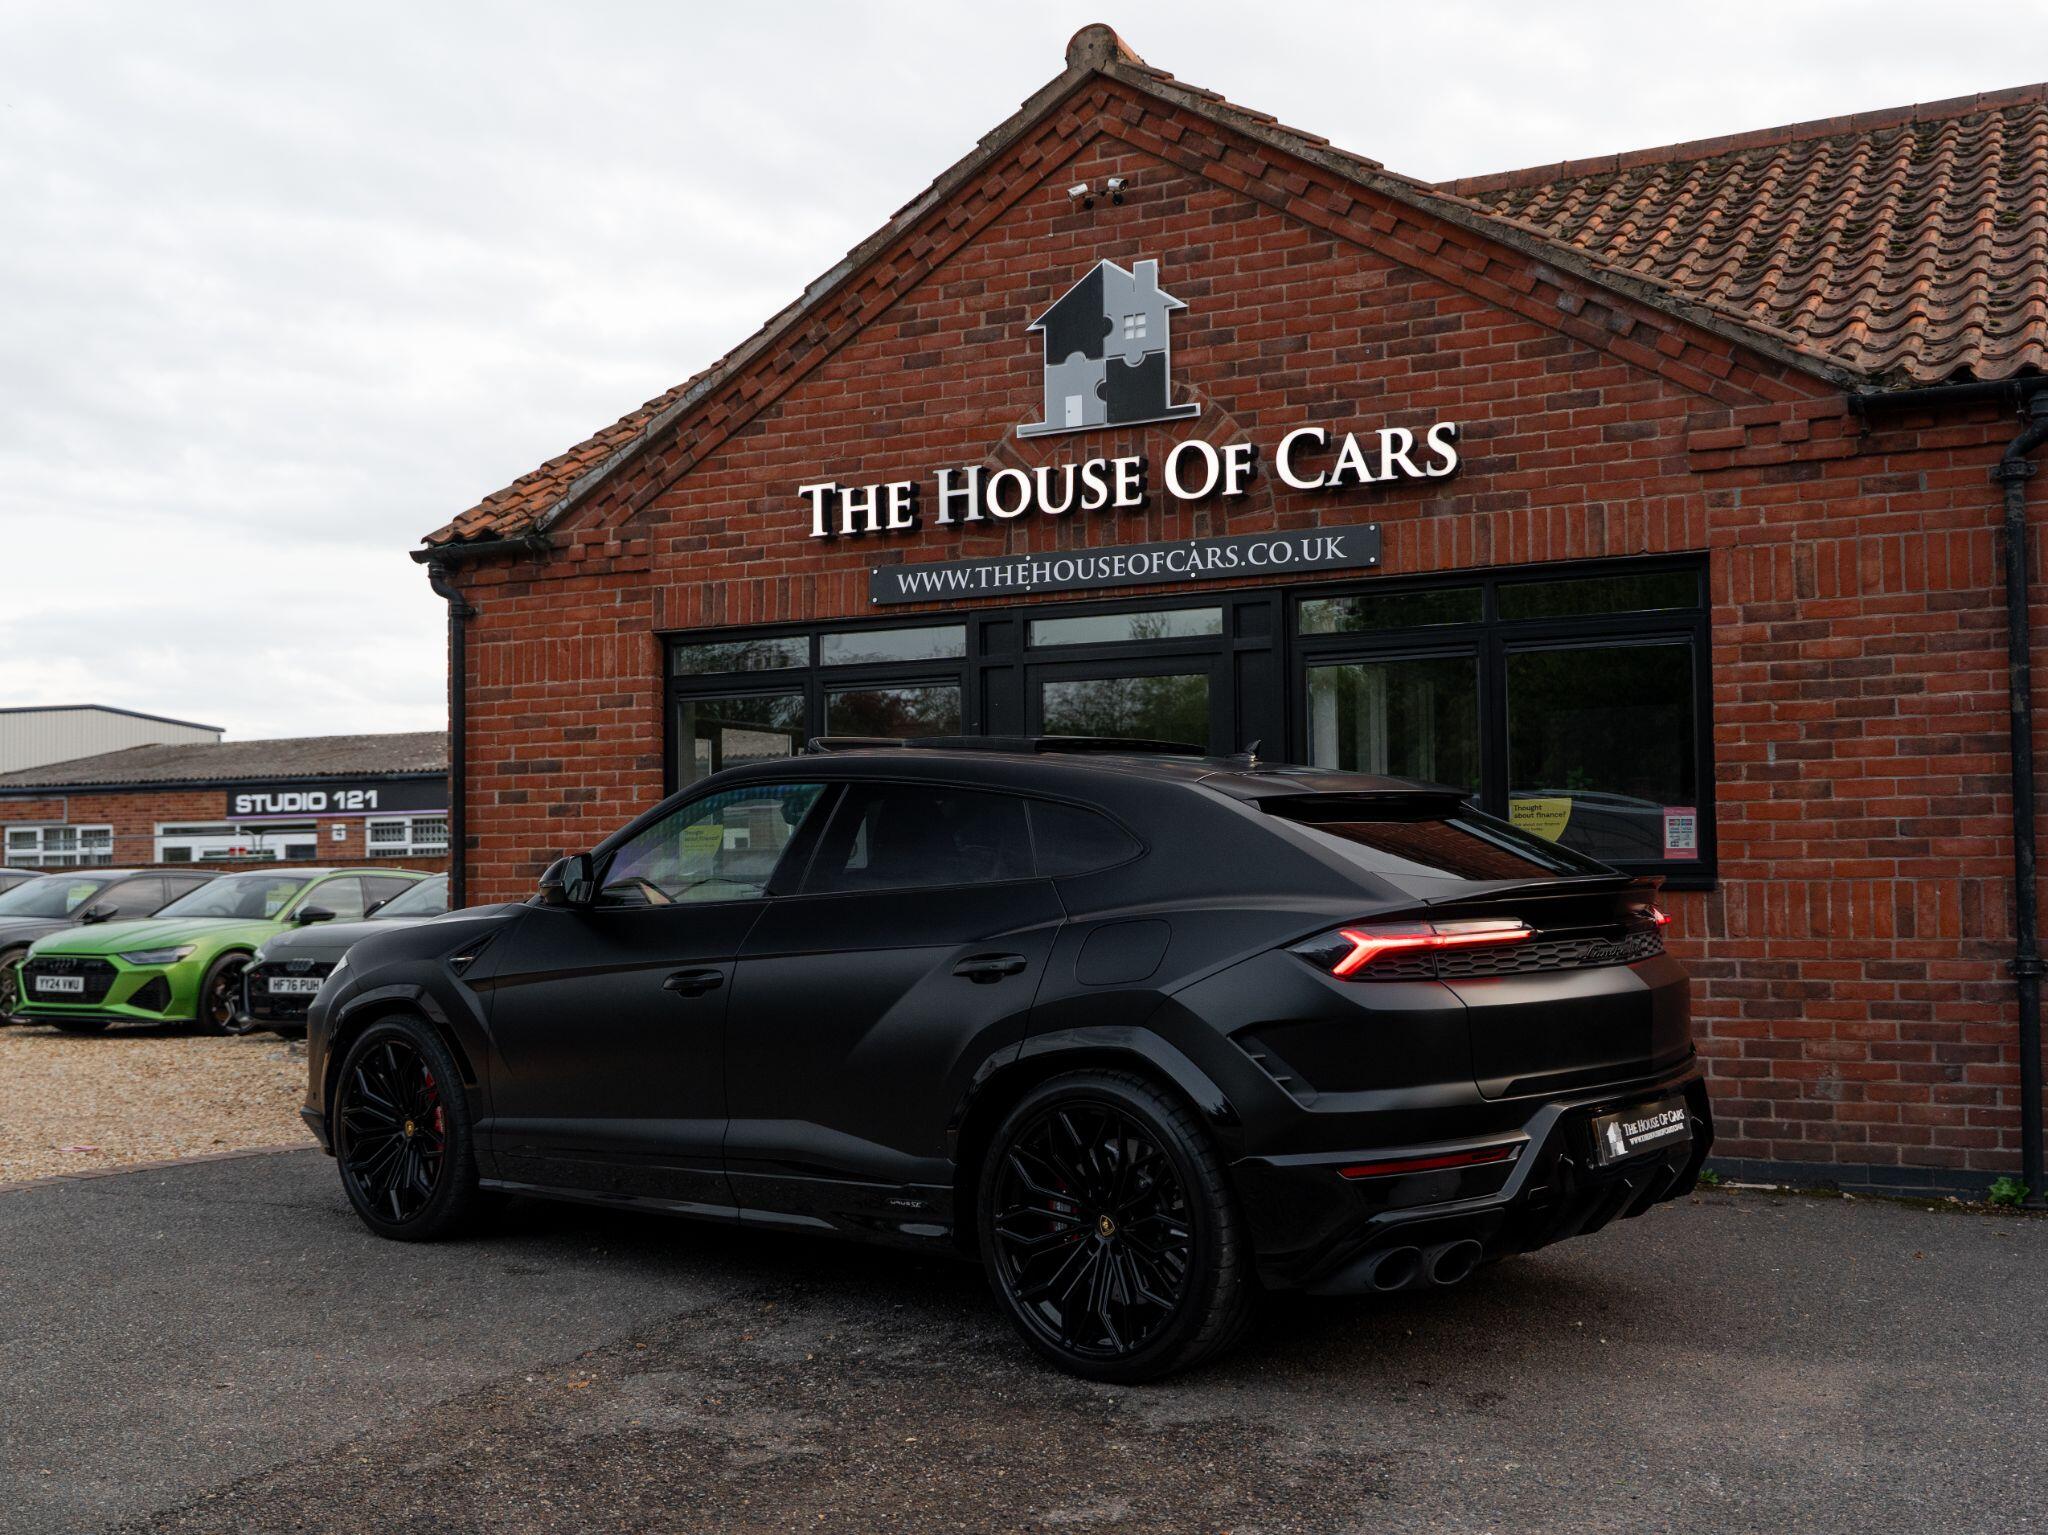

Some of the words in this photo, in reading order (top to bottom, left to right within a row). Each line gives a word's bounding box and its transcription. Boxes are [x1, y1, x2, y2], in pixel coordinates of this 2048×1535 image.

[896, 535, 1348, 595] WWW.THEHOUSEOFCARS.CO.UK
[235, 791, 327, 813] STUDIO
[333, 789, 378, 810] 121
[1513, 804, 1543, 812] Thought
[1536, 810, 1567, 819] finance?
[273, 979, 298, 991] HF76
